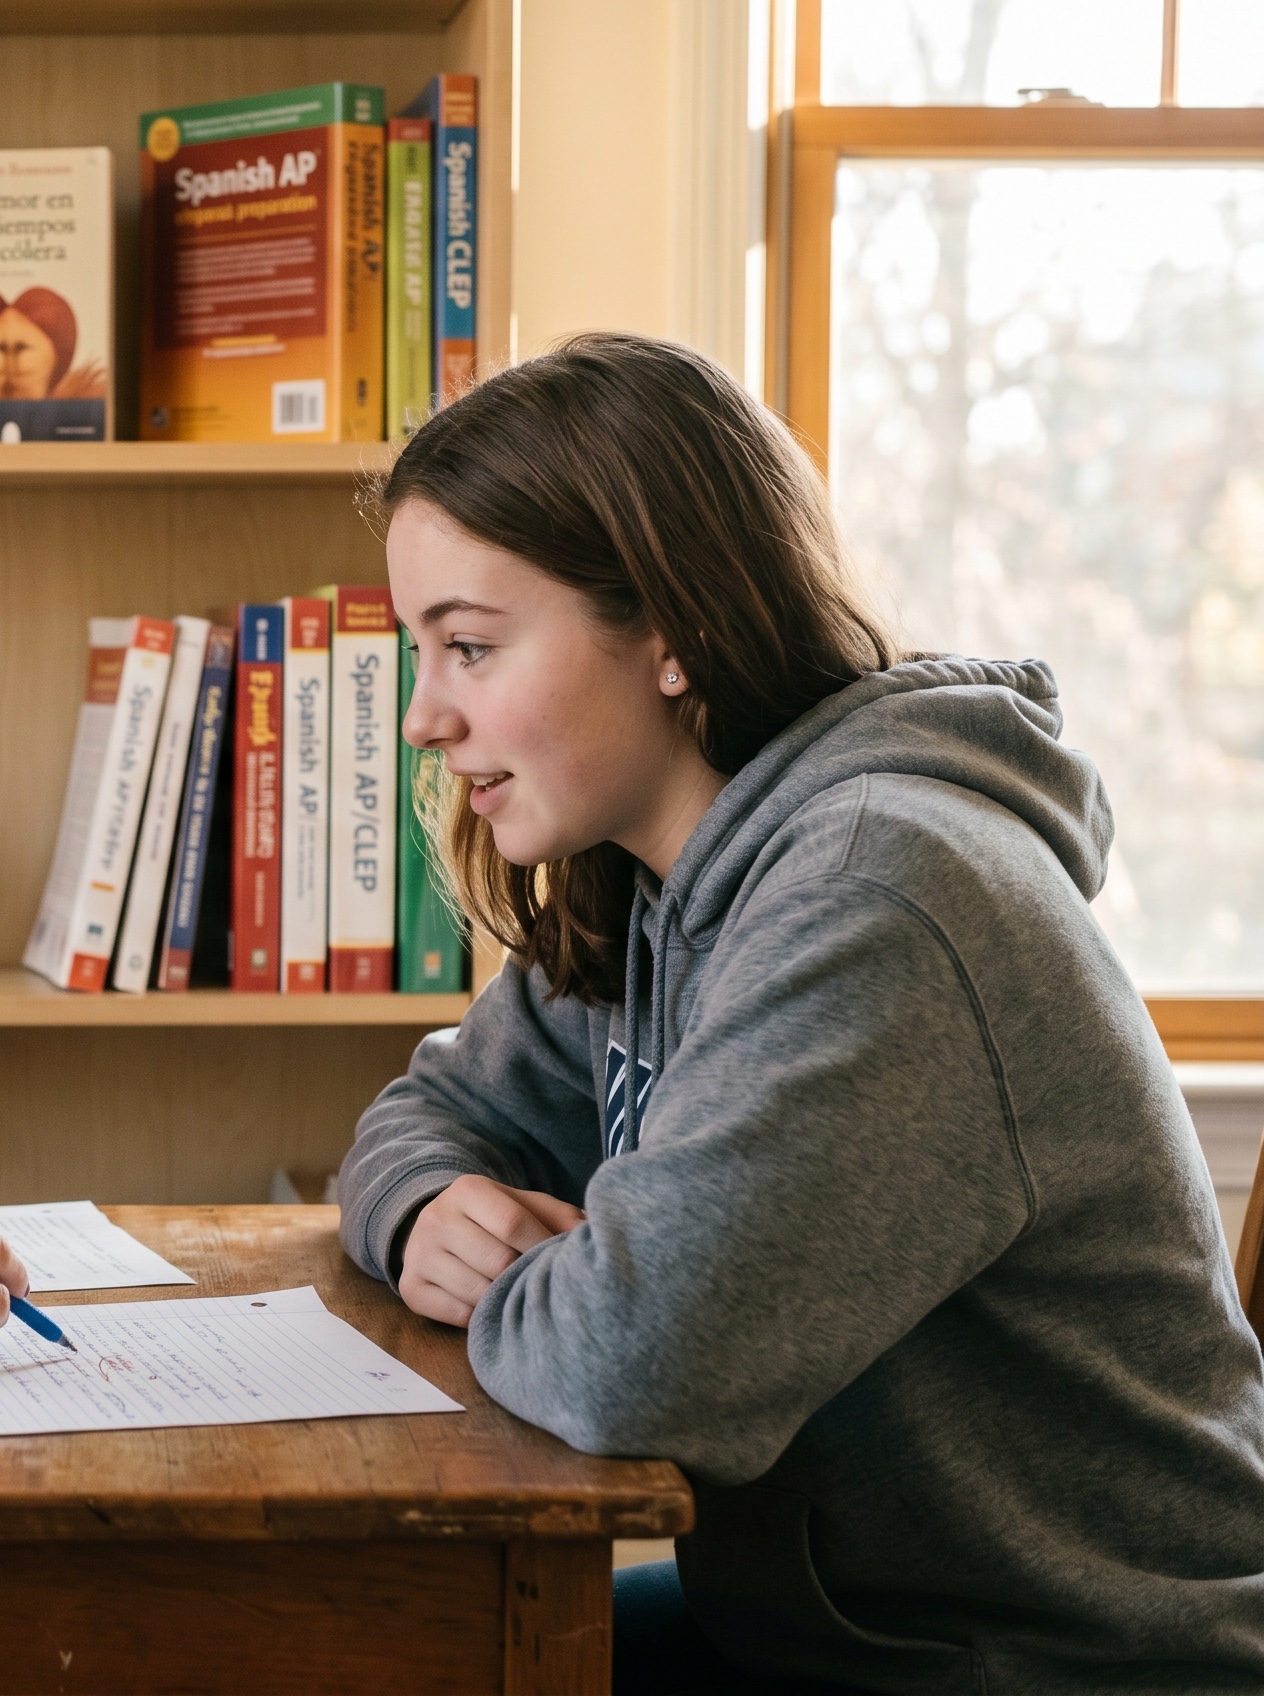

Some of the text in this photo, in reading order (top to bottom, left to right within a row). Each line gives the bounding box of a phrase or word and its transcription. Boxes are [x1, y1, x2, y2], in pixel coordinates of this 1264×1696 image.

[45, 193, 75, 210] en
[173, 149, 318, 208] Spanish AP
[442, 141, 472, 238] Spanish
[447, 239, 472, 310] CLEP
[117, 683, 153, 773] Spanish
[295, 676, 322, 774] Spanish
[350, 652, 381, 763] Spanish
[349, 771, 381, 893] AP/CLEP
